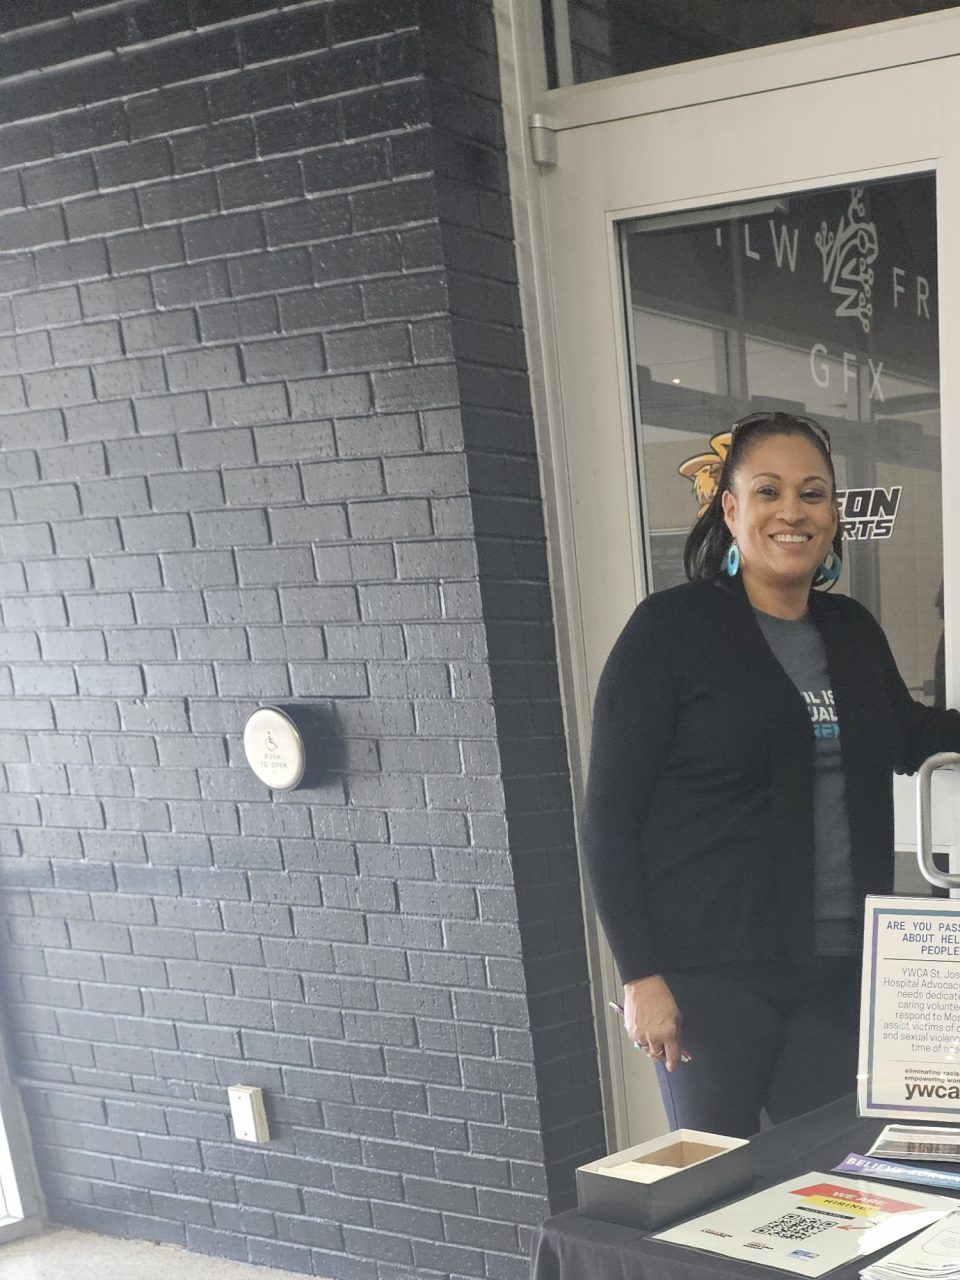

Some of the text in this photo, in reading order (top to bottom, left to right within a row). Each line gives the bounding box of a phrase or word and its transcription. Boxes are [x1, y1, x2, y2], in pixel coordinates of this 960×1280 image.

[810, 344, 885, 402] GFX
[887, 921, 906, 931] ARE
[913, 922, 932, 932] YOU
[902, 934, 935, 943] ABOUT
[902, 967, 928, 978] YWCA
[883, 978, 920, 988] Hospital
[896, 990, 924, 998] needs
[898, 1002, 925, 1012] caring
[896, 1012, 930, 1022] respond
[932, 1012, 942, 1020] to
[883, 1020, 913, 1030] assist
[912, 1022, 944, 1032] victims
[946, 1022, 956, 1032] of
[883, 1032, 898, 1040] and
[900, 1032, 928, 1042] sexual
[911, 1043, 932, 1052] time
[932, 1044, 942, 1053] of
[904, 1068, 942, 1077] eliminating
[904, 1076, 945, 1084] empowering
[904, 1082, 960, 1100] ywca
[832, 1191, 856, 1201] WE
[824, 1199, 872, 1212] HIRING!
